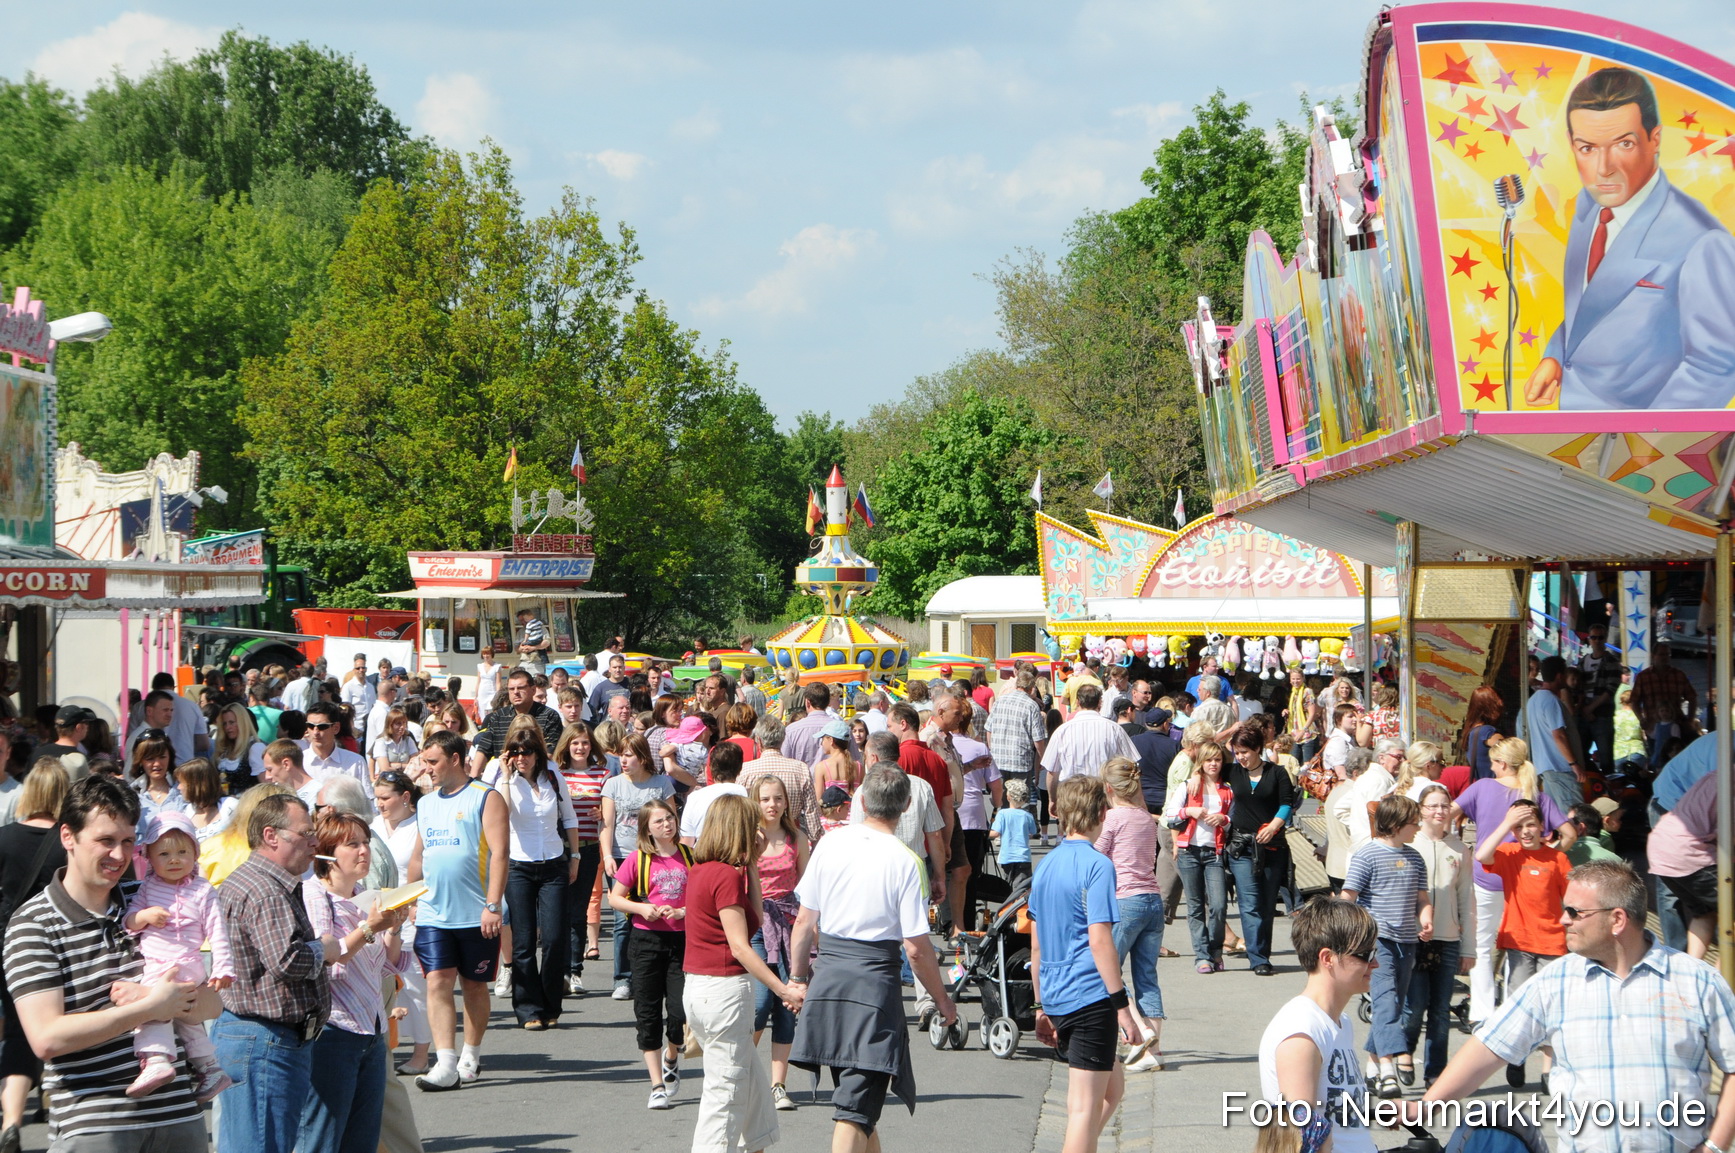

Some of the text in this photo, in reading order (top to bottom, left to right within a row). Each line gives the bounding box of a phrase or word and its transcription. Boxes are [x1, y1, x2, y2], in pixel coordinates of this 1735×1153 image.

[1206, 532, 1284, 559] SPIEL
[427, 564, 484, 578] Enterprise
[500, 559, 594, 578] ENTERPRISE
[0, 571, 92, 592] CORN
[426, 827, 449, 838] Gran
[425, 837, 461, 848] anaria
